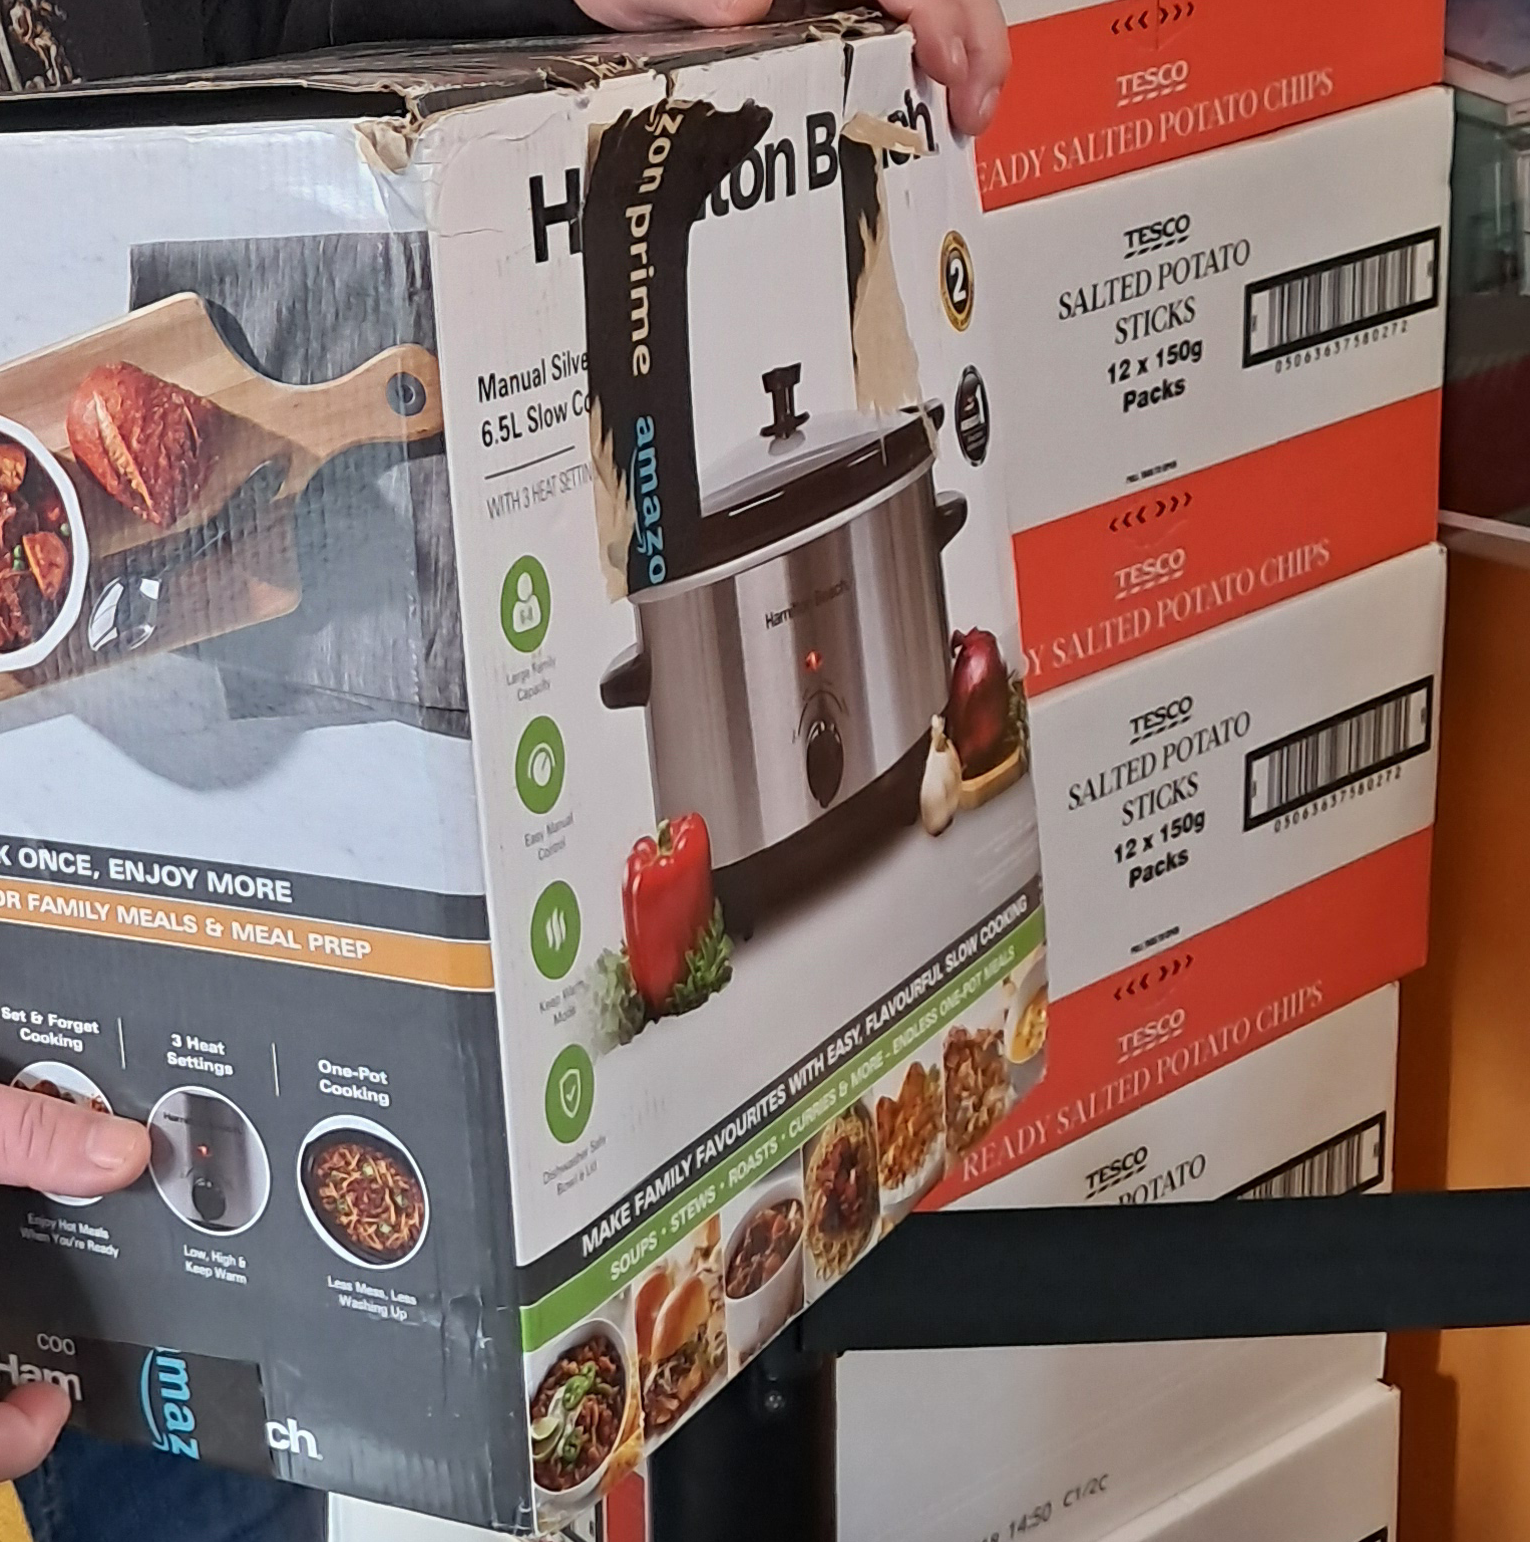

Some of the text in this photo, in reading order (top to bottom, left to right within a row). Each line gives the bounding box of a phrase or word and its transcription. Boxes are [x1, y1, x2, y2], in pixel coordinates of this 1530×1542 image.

[1117, 60, 1188, 94] TESCO
[1124, 214, 1190, 249] TESCO
[626, 204, 653, 377] prime
[950, 258, 966, 303] 2
[1058, 238, 1251, 321] SALTED POTATO
[1114, 296, 1196, 345] STICKS
[477, 358, 547, 403] Manual
[481, 400, 568, 448] 6.5L Slow
[486, 476, 557, 520] WITH 3 HEAT
[1129, 696, 1192, 734] TESCO
[1068, 710, 1251, 811] SALTED POTATO
[1121, 772, 1199, 827] STICKS
[18, 847, 100, 882] ONCE,
[108, 859, 197, 891] ENJOY
[206, 871, 292, 904] MORE
[27, 892, 109, 922] FAMILY
[117, 903, 197, 936] MEALS
[205, 917, 223, 938] &
[231, 921, 301, 952] MEAL
[308, 934, 371, 960] PREP
[1, 1006, 99, 1035] Set & Forget
[20, 1027, 83, 1052] Cooking
[171, 1033, 225, 1056] 3 Heat
[166, 1051, 234, 1076] Settings
[318, 1059, 388, 1086] One-Pot
[581, 1208, 631, 1257] MAKE
[634, 1157, 692, 1218] FAMILY
[694, 1089, 786, 1171] FAVOURITES
[788, 1055, 826, 1098] WITH
[826, 1024, 863, 1066] EASY,
[865, 966, 943, 1036] FLAVOURFUL
[945, 938, 979, 976] SLOW
[979, 895, 1028, 951] COOKING
[319, 1079, 390, 1107] Cooking
[610, 1230, 658, 1281] SOUPS
[670, 1186, 716, 1232] STEWS
[728, 1138, 778, 1188] ROASTS
[788, 1090, 837, 1139] CURRIES
[851, 1052, 885, 1091] MORE
[892, 1006, 938, 1056] ENDLESS
[939, 969, 984, 1020] ONE-POT
[984, 945, 1016, 986] MEALS
[1085, 1146, 1148, 1189] TESCO
[21, 1227, 50, 1245] When
[87, 1238, 119, 1259] Ready
[27, 1212, 110, 1240] Enjoy Hot Meals
[183, 1244, 247, 1269] Low, High &
[185, 1262, 248, 1285] Keep Warm
[327, 1275, 417, 1307] Less Mess, Less
[338, 1294, 408, 1321] Washing Up
[1063, 1474, 1109, 1507] C1/2C
